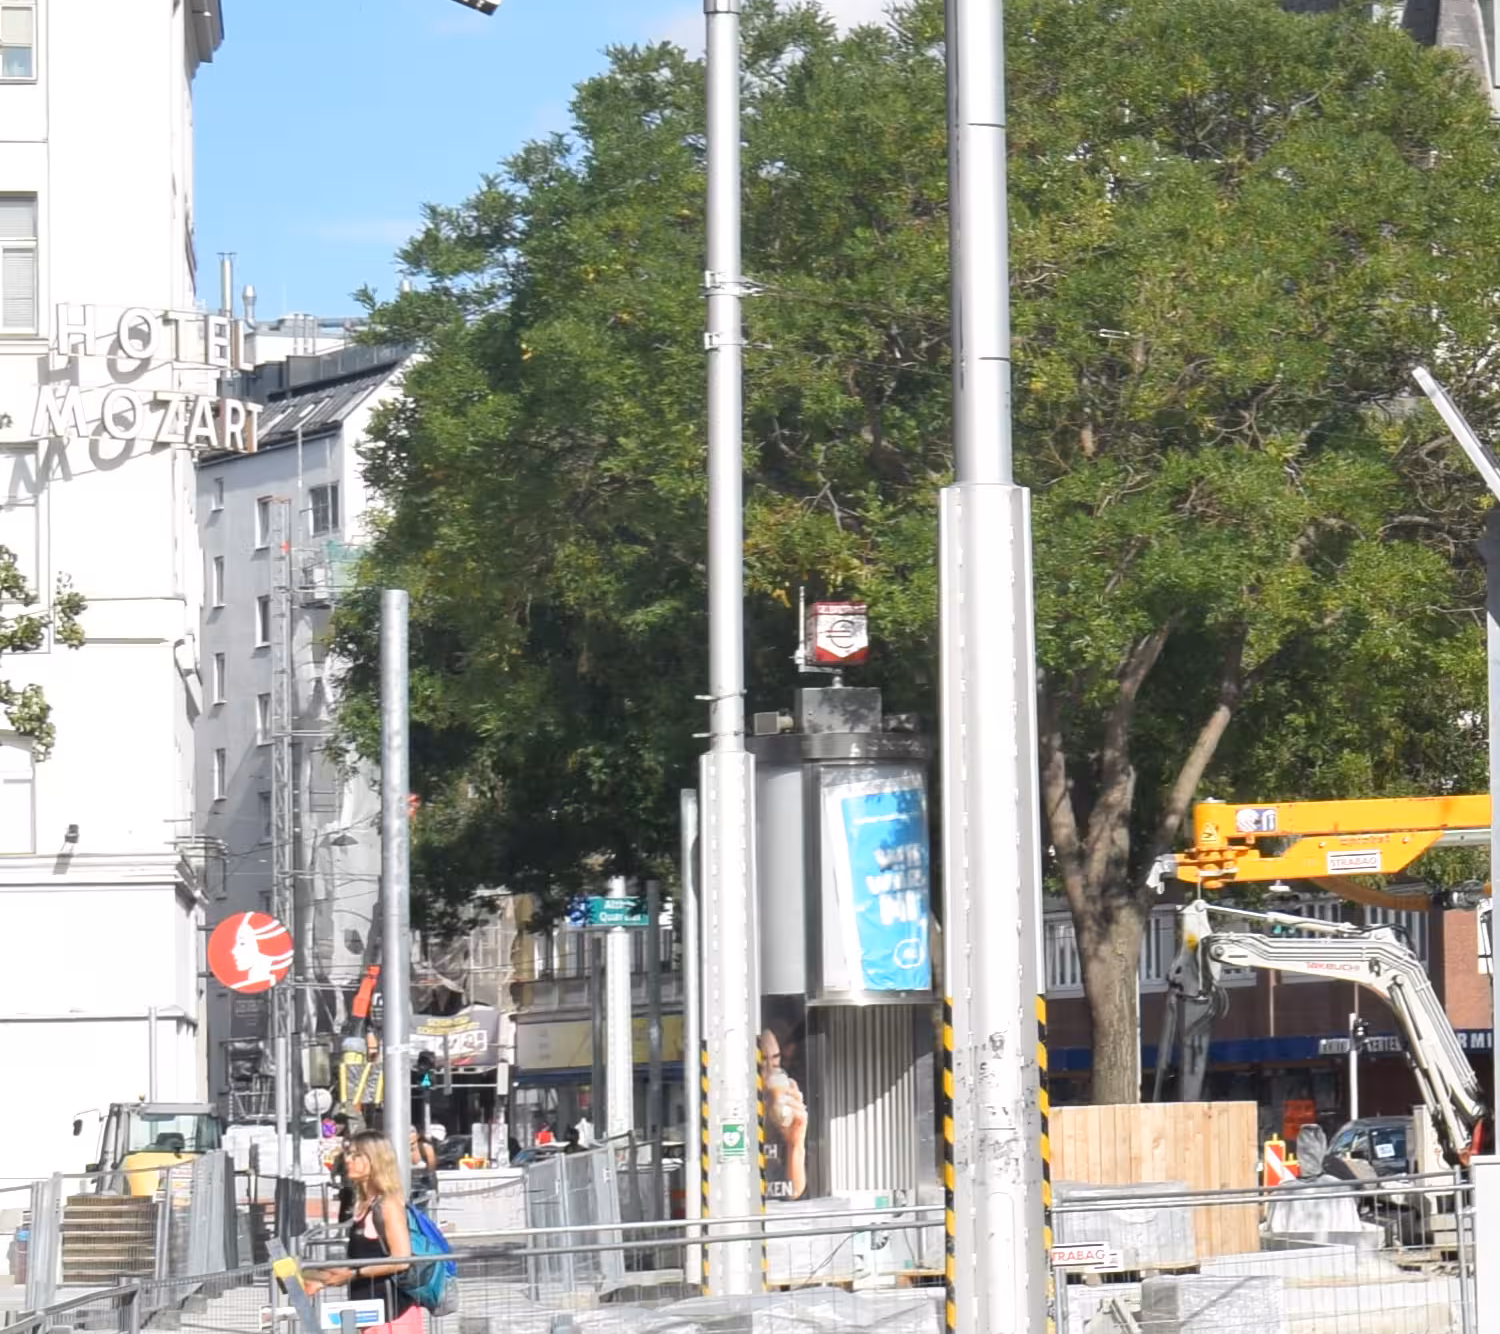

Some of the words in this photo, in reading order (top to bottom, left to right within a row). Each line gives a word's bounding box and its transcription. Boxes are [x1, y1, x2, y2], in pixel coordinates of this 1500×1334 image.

[56, 302, 256, 371] HOTEL
[30, 384, 264, 453] MOZART
[1329, 856, 1378, 867] STRABAG
[1051, 1249, 1106, 1262] TRABAG
